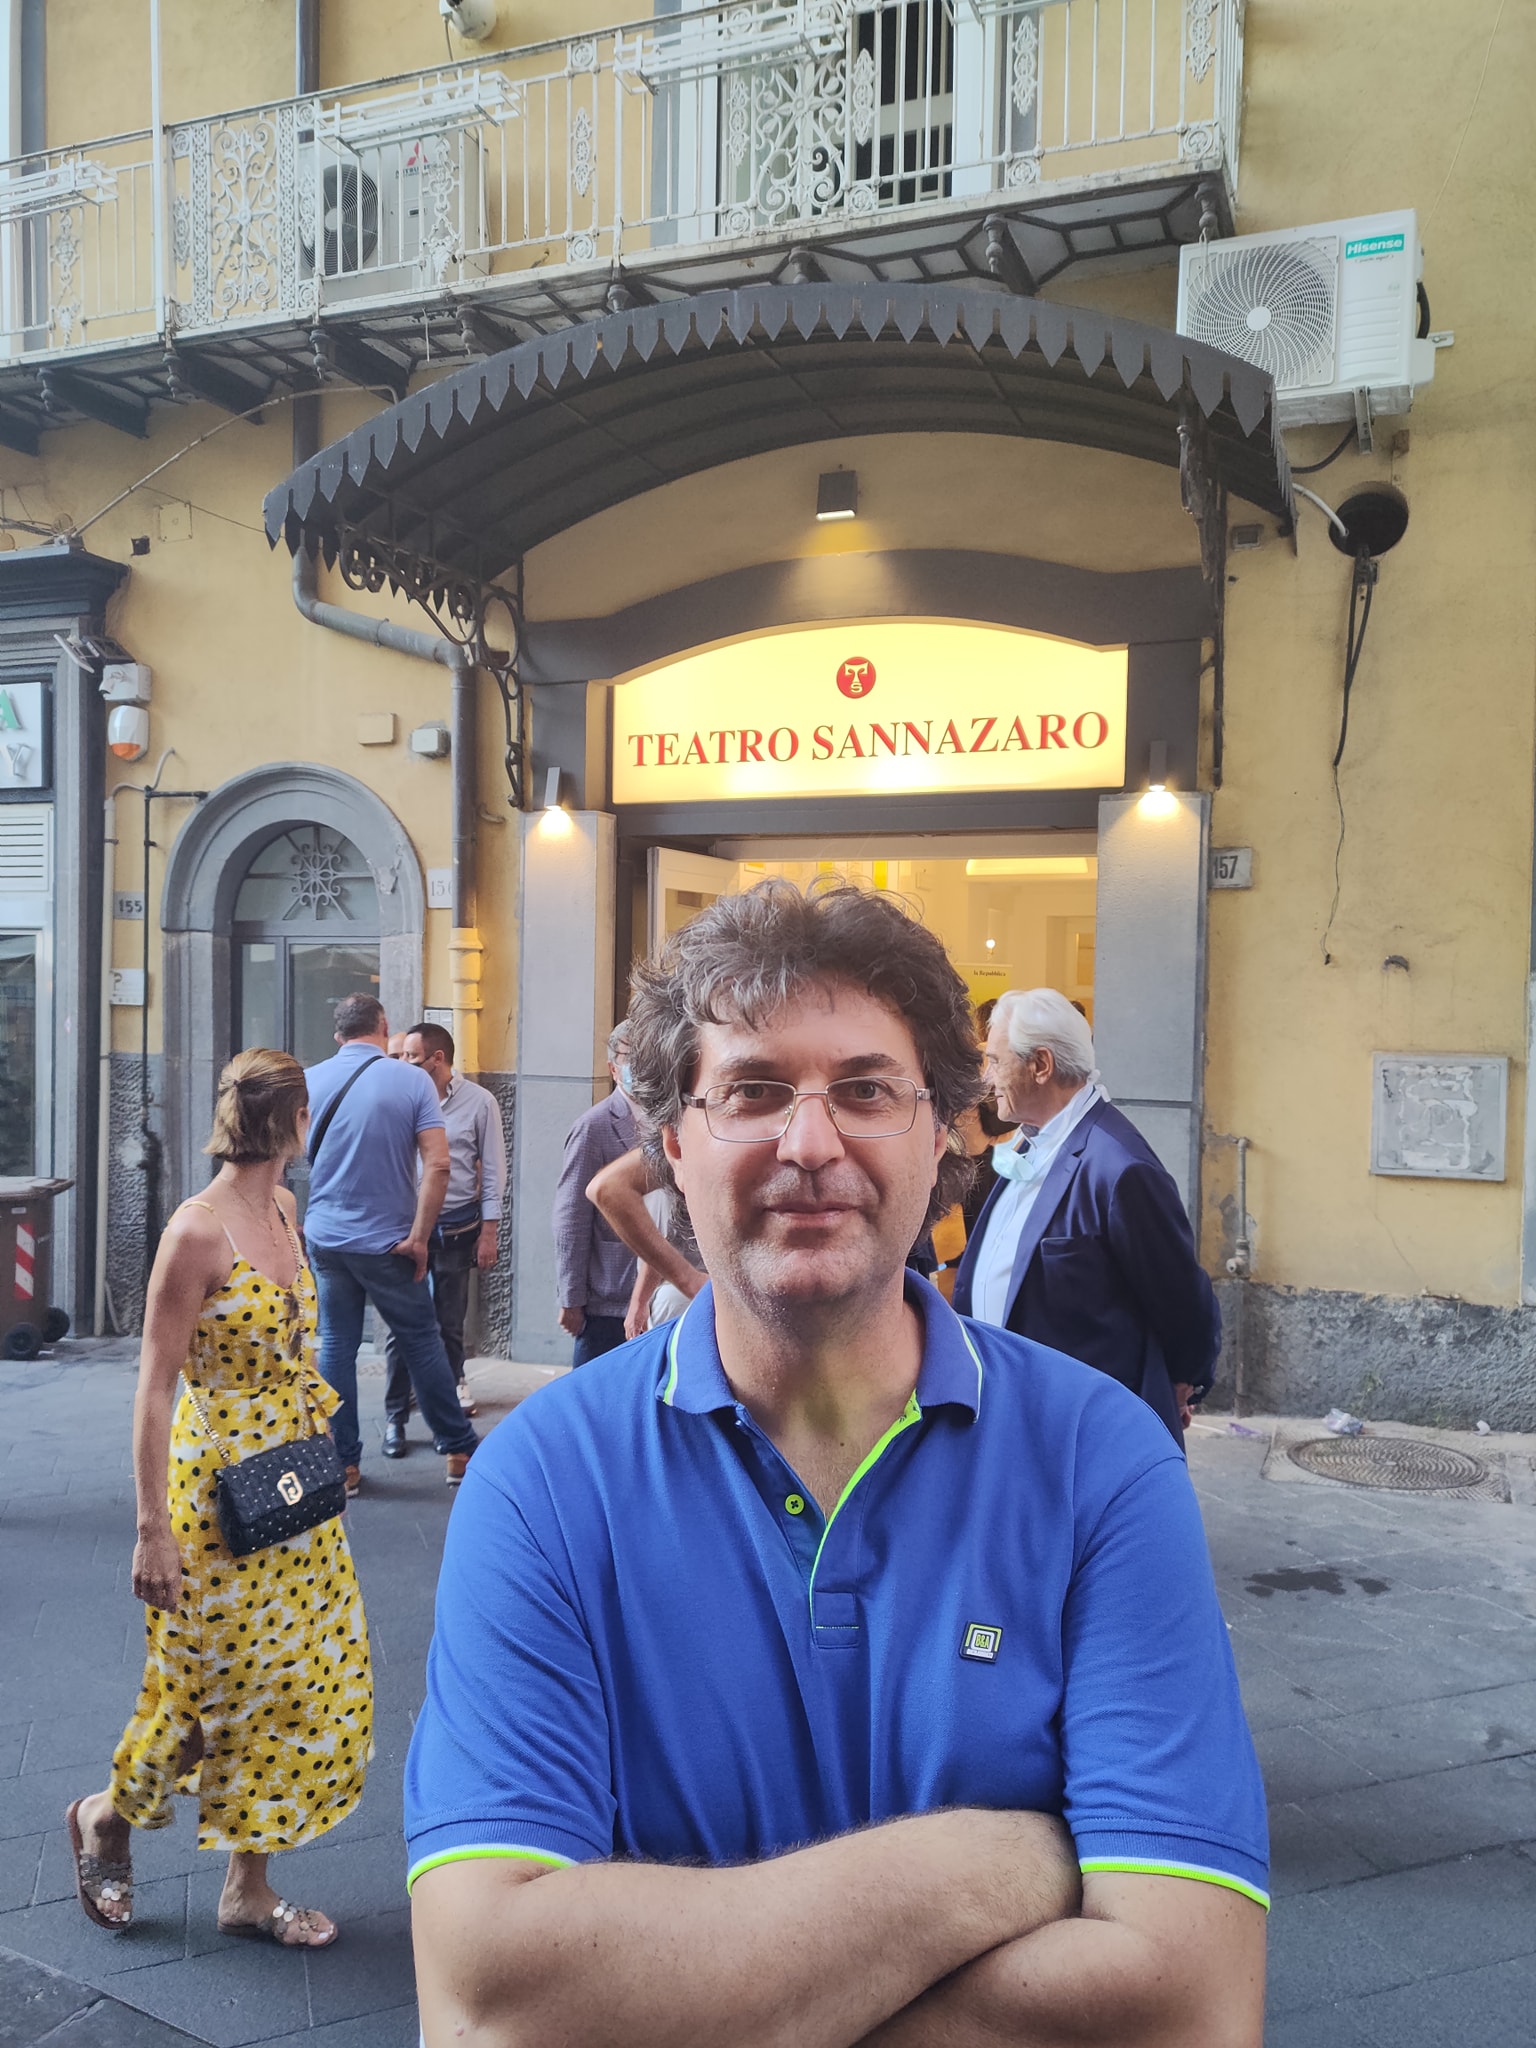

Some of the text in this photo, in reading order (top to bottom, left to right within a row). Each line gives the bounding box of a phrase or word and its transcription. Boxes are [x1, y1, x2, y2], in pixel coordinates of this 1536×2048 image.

[1347, 239, 1403, 256] Hisense
[627, 711, 1110, 767] TEATRO SANNAZARO
[1214, 854, 1239, 880] 157
[118, 898, 143, 913] 155
